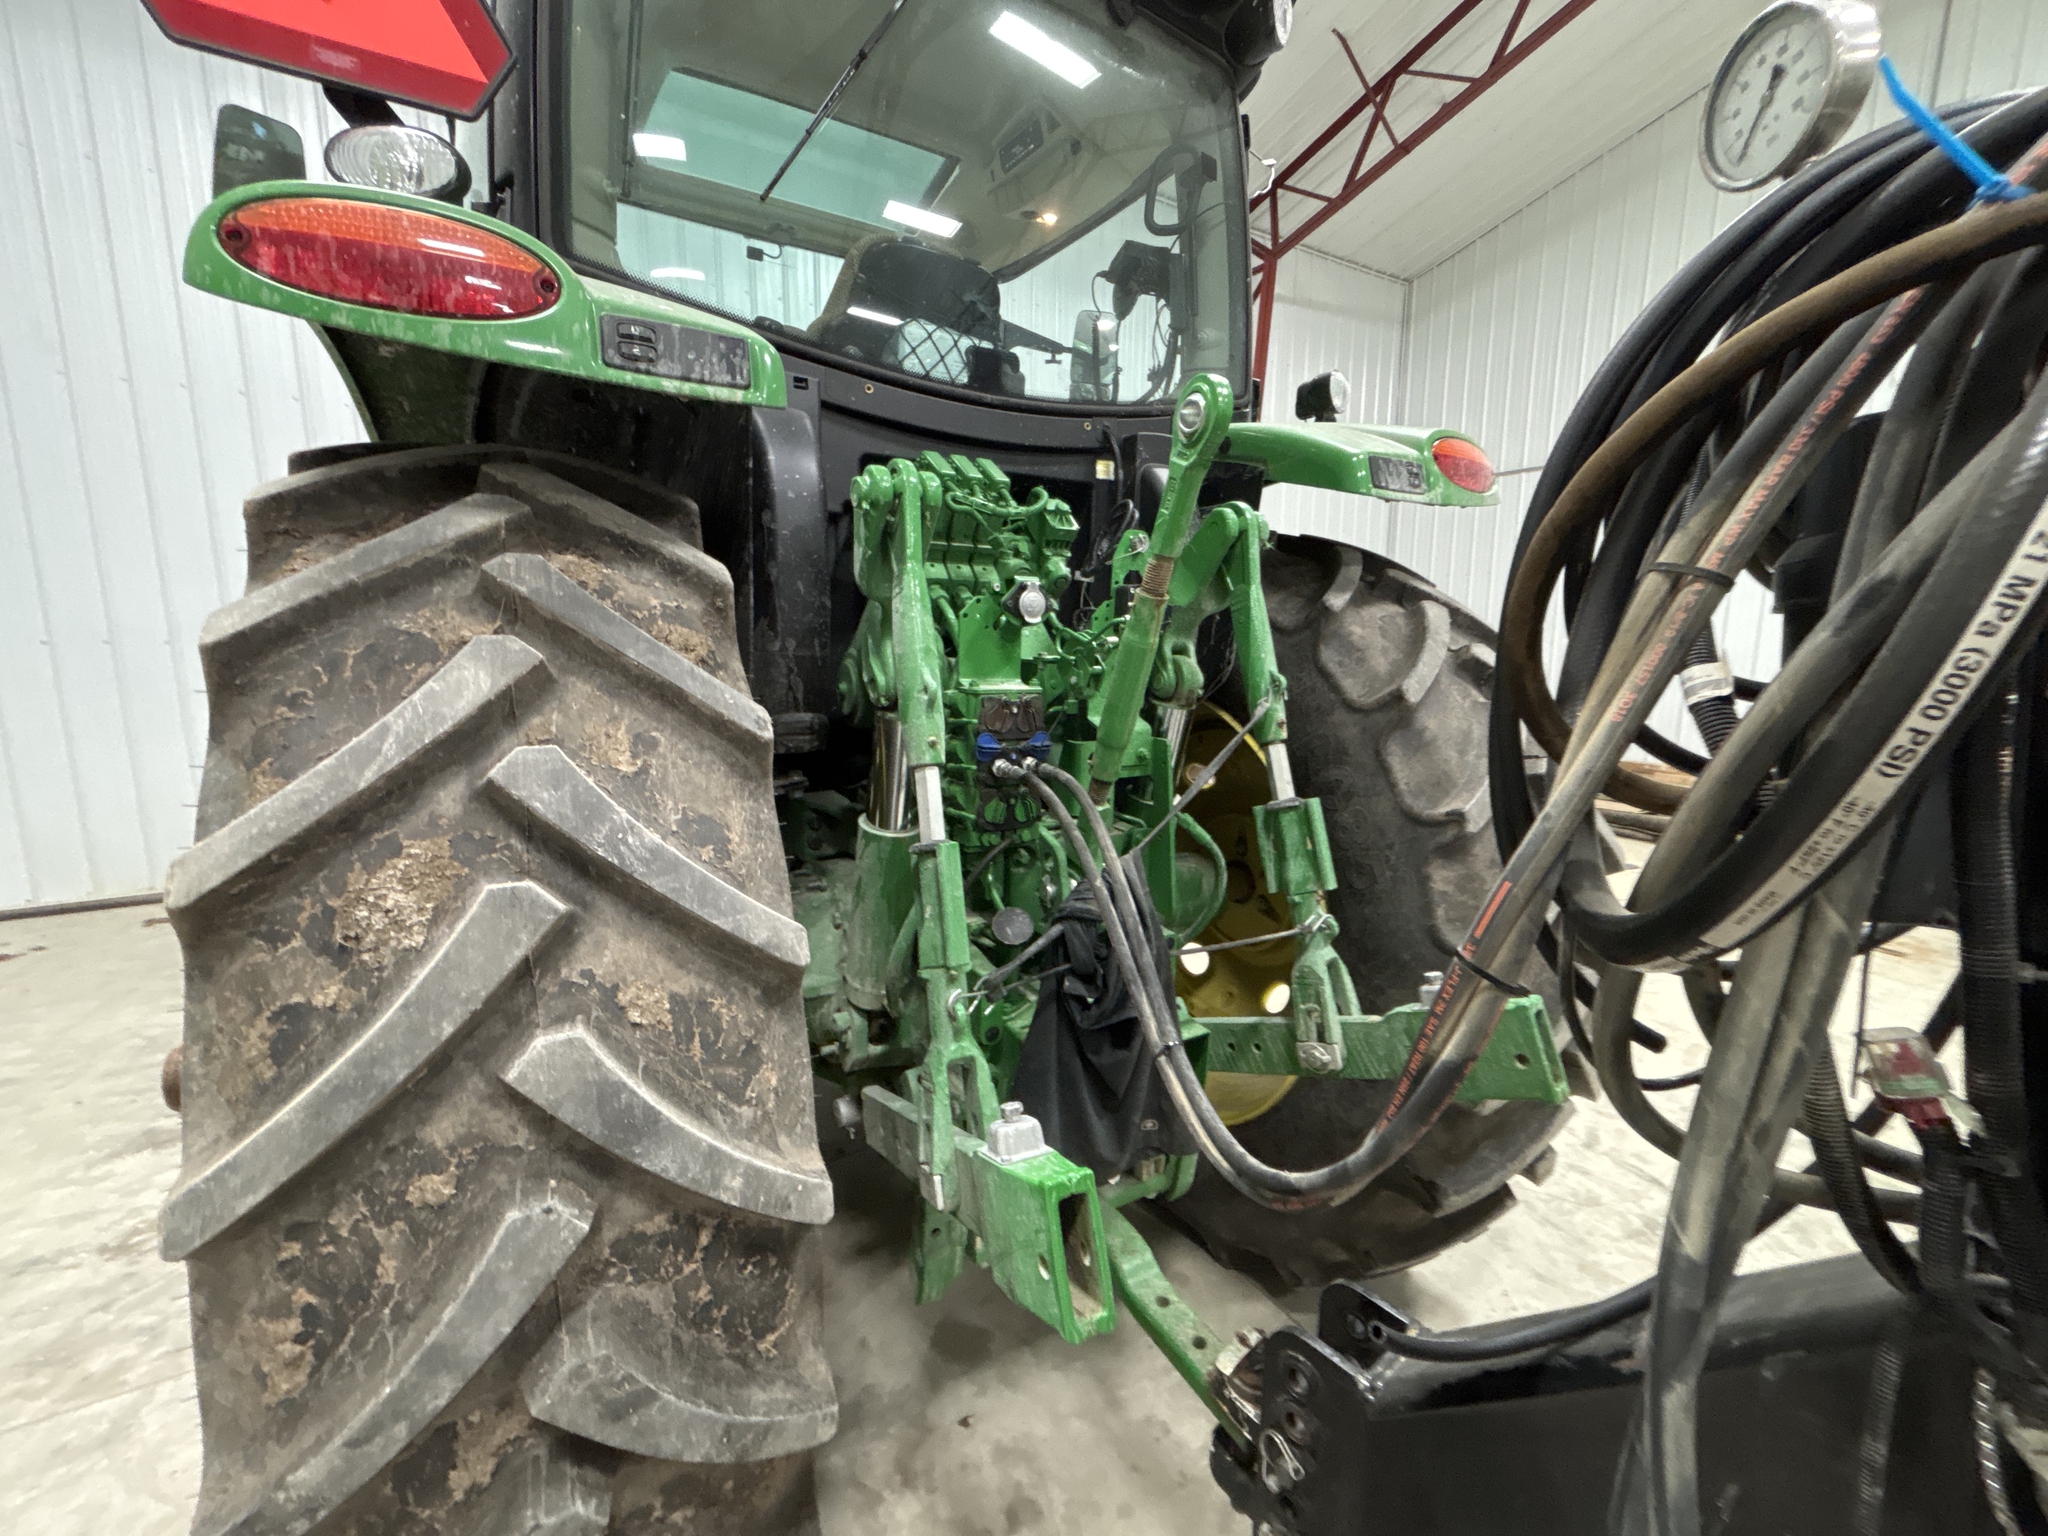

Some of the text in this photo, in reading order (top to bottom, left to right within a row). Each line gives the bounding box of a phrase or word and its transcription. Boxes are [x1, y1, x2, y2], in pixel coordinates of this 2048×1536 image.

[1765, 453, 1795, 487] BAR
[1739, 489, 1769, 520] MAX
[1724, 524, 1745, 547] WP
[1972, 574, 2037, 637] MPa
[1919, 647, 1991, 721] (3000
[1874, 726, 1933, 778] PSI)
